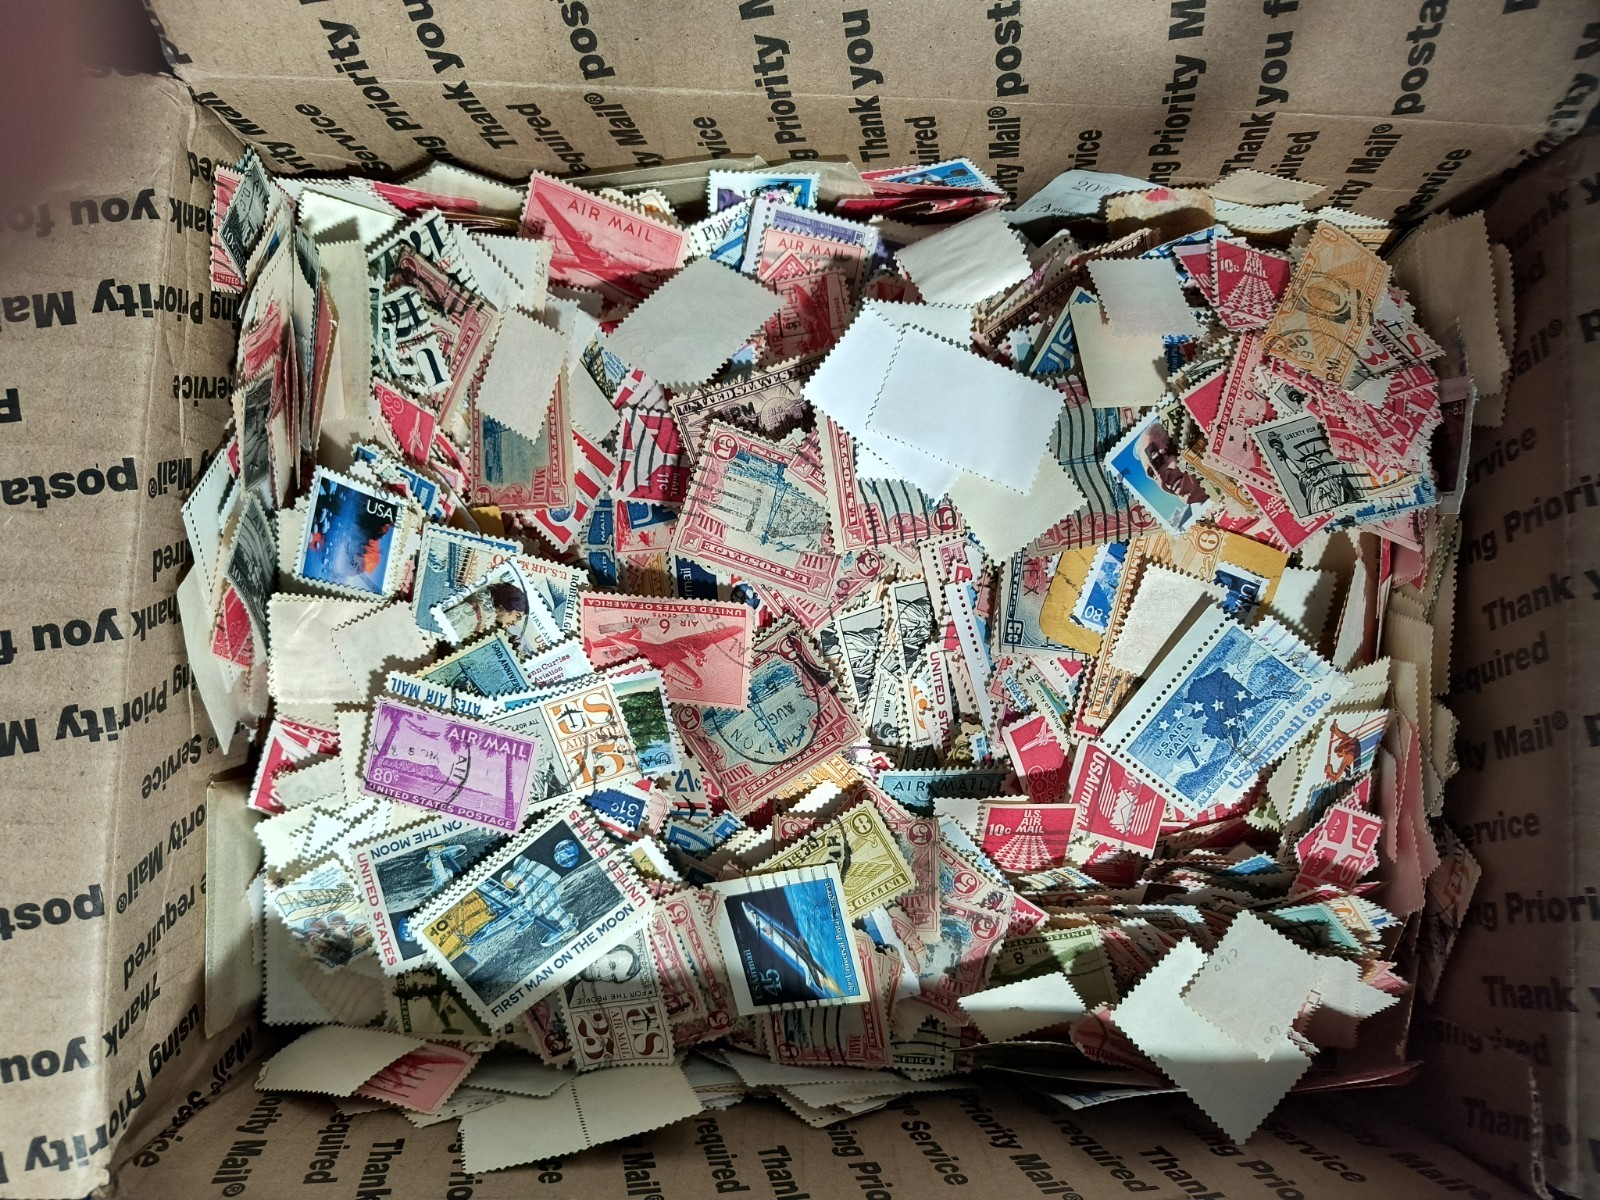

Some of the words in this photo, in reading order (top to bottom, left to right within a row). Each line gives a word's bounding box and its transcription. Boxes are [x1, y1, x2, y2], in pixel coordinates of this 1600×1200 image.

[406, 0, 465, 74] you
[561, 0, 616, 80] pos
[842, 8, 884, 92] you
[318, 18, 424, 133] Priority
[753, 34, 806, 150] Priority
[1148, 54, 1206, 160] Priority
[1220, 110, 1276, 176] Thank
[1256, 30, 1295, 107] you
[442, 79, 517, 150] Thank
[848, 95, 891, 163] Thank
[70, 188, 165, 228] you
[565, 198, 602, 223] AIR
[607, 214, 655, 244] MAIL
[777, 237, 805, 252] AIR
[809, 244, 847, 261] MAIL
[1246, 259, 1264, 270] AIR
[214, 272, 241, 286] UNITED
[1242, 266, 1269, 279] MAIL
[92, 278, 204, 326] Priority
[678, 386, 738, 416] UNITED
[1214, 407, 1236, 452] AMERICA
[1284, 427, 1308, 441] LIBERTY
[365, 498, 395, 521] USA
[568, 574, 581, 606] ROBERT
[587, 598, 638, 610] AMERICA
[641, 601, 653, 611] OF
[1481, 574, 1576, 633] Thank
[530, 611, 545, 633] FIRST
[623, 615, 651, 627] MAIL
[656, 603, 697, 613] STATES
[679, 619, 700, 628] AIR
[700, 606, 743, 617] UNITED
[32, 607, 125, 651] you
[658, 618, 670, 635] 6
[533, 666, 563, 683] Aviation
[541, 653, 571, 670] Curtiss
[391, 676, 422, 696] MAIL
[929, 650, 947, 706] UNITED
[55, 670, 168, 742] Priority
[425, 688, 449, 705] AIR
[549, 690, 614, 737] US
[448, 727, 479, 744] AIR
[484, 736, 528, 759] MAIL
[564, 736, 590, 752] AIR
[588, 724, 623, 744] MAIL
[1164, 730, 1193, 760] MAIL
[1496, 709, 1570, 756] Mail®
[141, 732, 203, 799] Service
[1227, 713, 1307, 790] USAirmail
[372, 767, 401, 785] 80¢
[892, 782, 929, 793] AIR
[938, 778, 987, 793] MAIL
[1196, 769, 1235, 808] ALASKA
[369, 783, 411, 801] UNITED
[412, 794, 455, 814] STATES
[457, 808, 514, 831] POSTAGE
[1019, 817, 1043, 827] AIR
[1023, 808, 1043, 819] U.S.
[412, 827, 442, 846] THE
[443, 818, 464, 834] ON
[568, 809, 609, 860] STATES
[1014, 824, 1046, 834] MAIL
[370, 839, 412, 861] MOON
[606, 858, 647, 908] UNITED
[356, 850, 381, 908] UNITED
[372, 909, 399, 968] STATES
[123, 876, 200, 991] required
[490, 988, 527, 1019] FIRST
[526, 964, 554, 995] MAN
[553, 951, 576, 970] ON
[569, 931, 598, 960] THE
[598, 902, 636, 938] MOON
[610, 991, 628, 1001] THE
[629, 989, 648, 999] FOR
[764, 968, 784, 998] 45
[1481, 974, 1580, 1013] Thank
[101, 971, 162, 1059] Thank
[576, 994, 608, 1006] PEOPLE
[610, 1010, 624, 1030] AIR
[0, 1036, 96, 1084] you
[615, 1033, 632, 1058] MAIL
[24, 1068, 148, 1173] Priority
[210, 1138, 269, 1199] Mail®
[693, 1117, 750, 1194] required
[899, 1119, 969, 1187] Service
[1055, 1114, 1161, 1194] required
